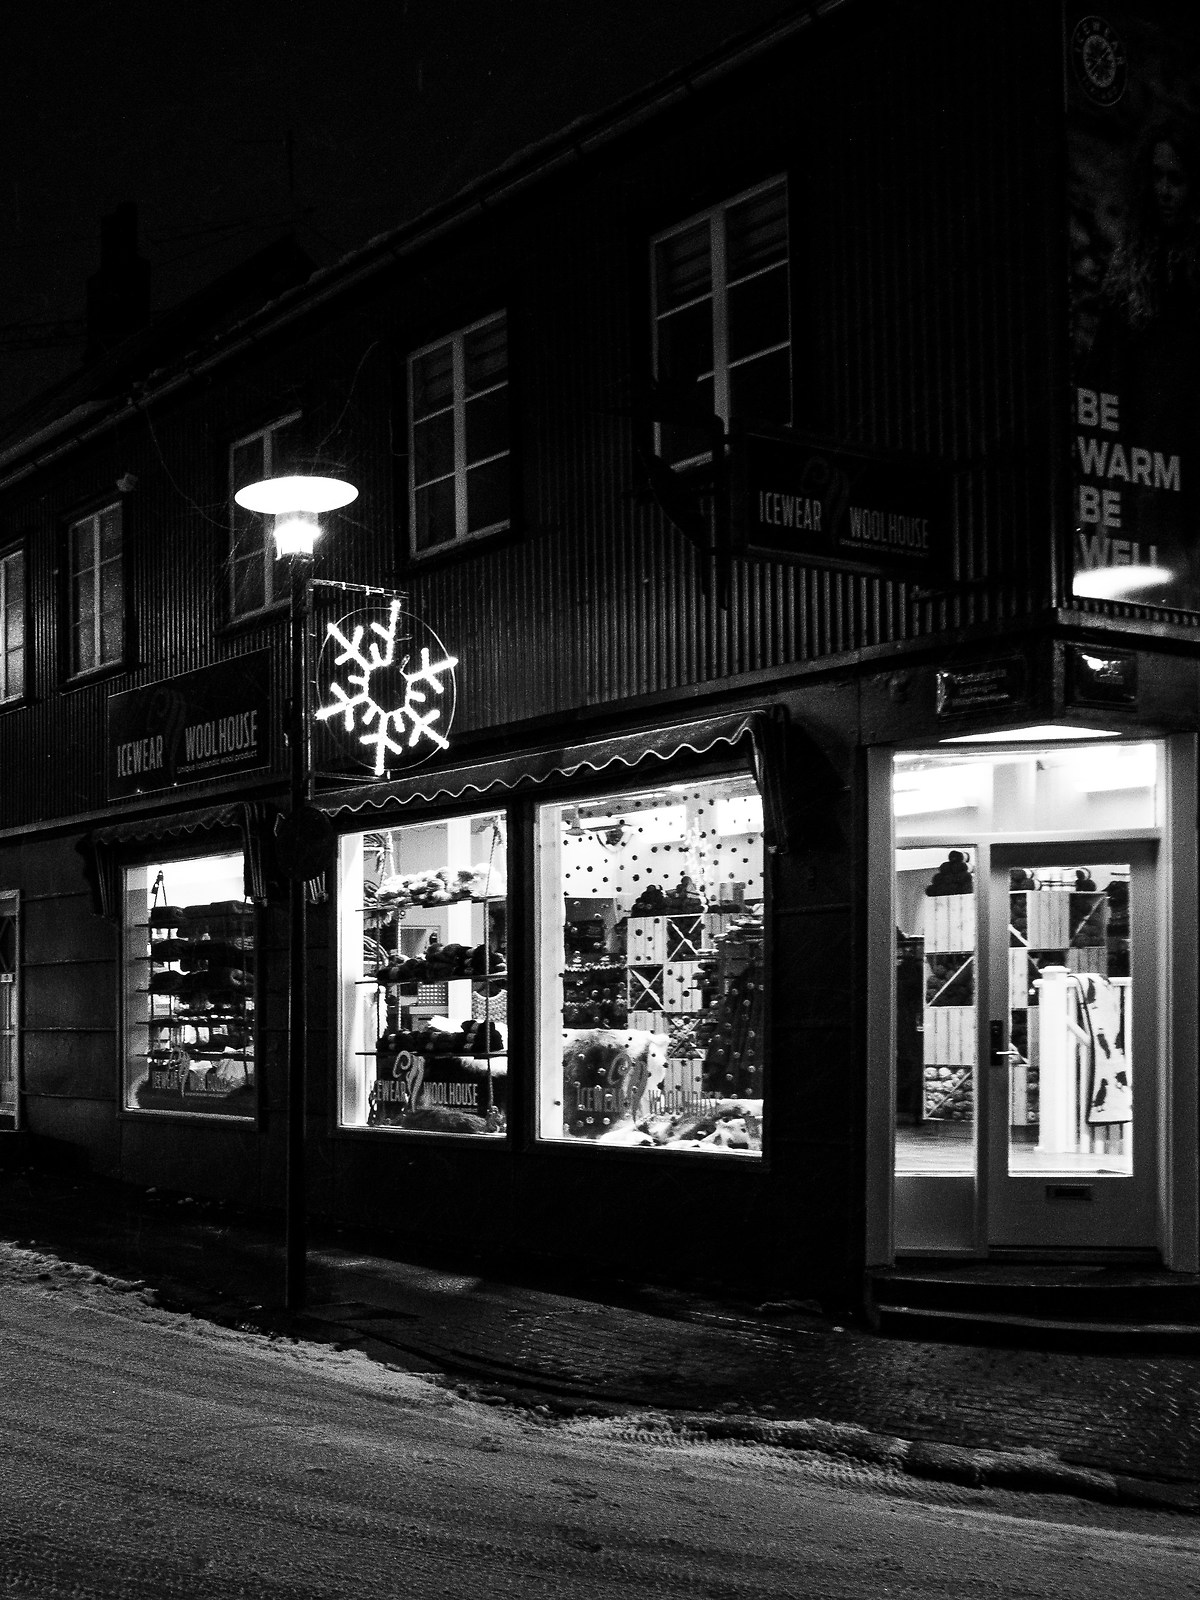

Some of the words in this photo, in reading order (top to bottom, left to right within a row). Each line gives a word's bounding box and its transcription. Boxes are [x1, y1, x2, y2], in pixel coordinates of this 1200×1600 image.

[1077, 387, 1120, 432] BE
[1077, 435, 1182, 491] WARM
[759, 489, 822, 532] ICEWEAR
[1079, 484, 1122, 528] BE
[117, 734, 163, 778] ICEWEAR
